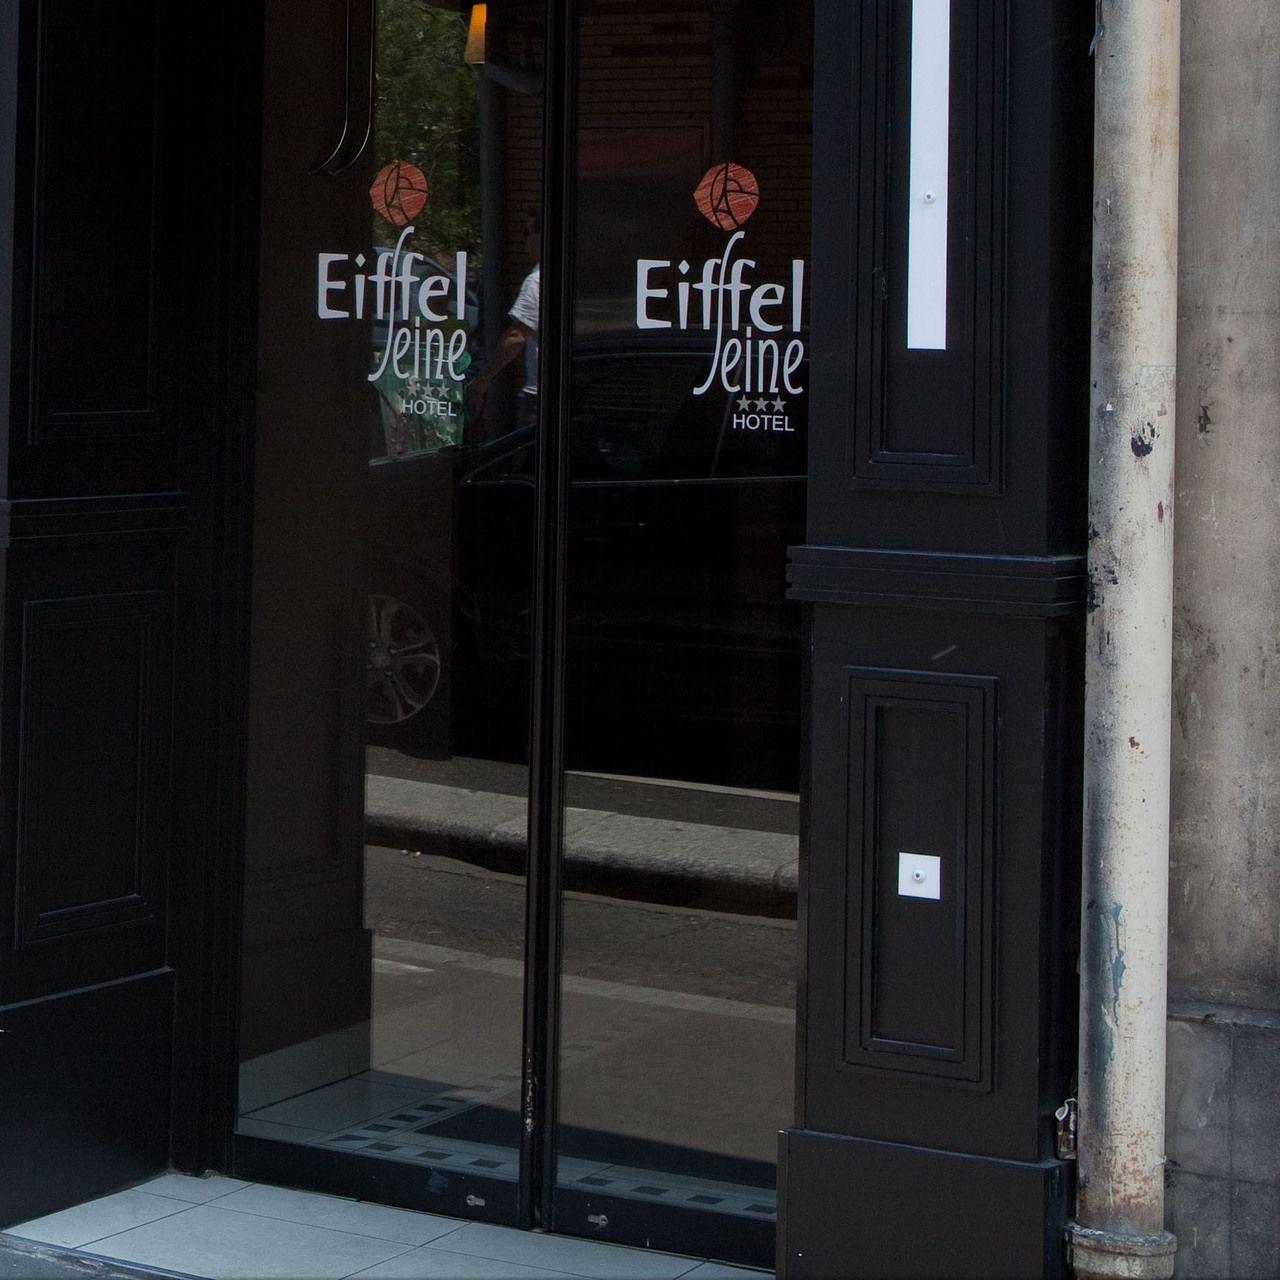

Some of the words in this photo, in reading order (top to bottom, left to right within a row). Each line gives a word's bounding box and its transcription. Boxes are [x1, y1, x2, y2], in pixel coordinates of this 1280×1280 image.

[317, 250, 468, 322] Eiffel
[635, 258, 804, 332] Eiffel
[402, 398, 457, 417] HOTEL
[732, 413, 795, 432] HOTEL
